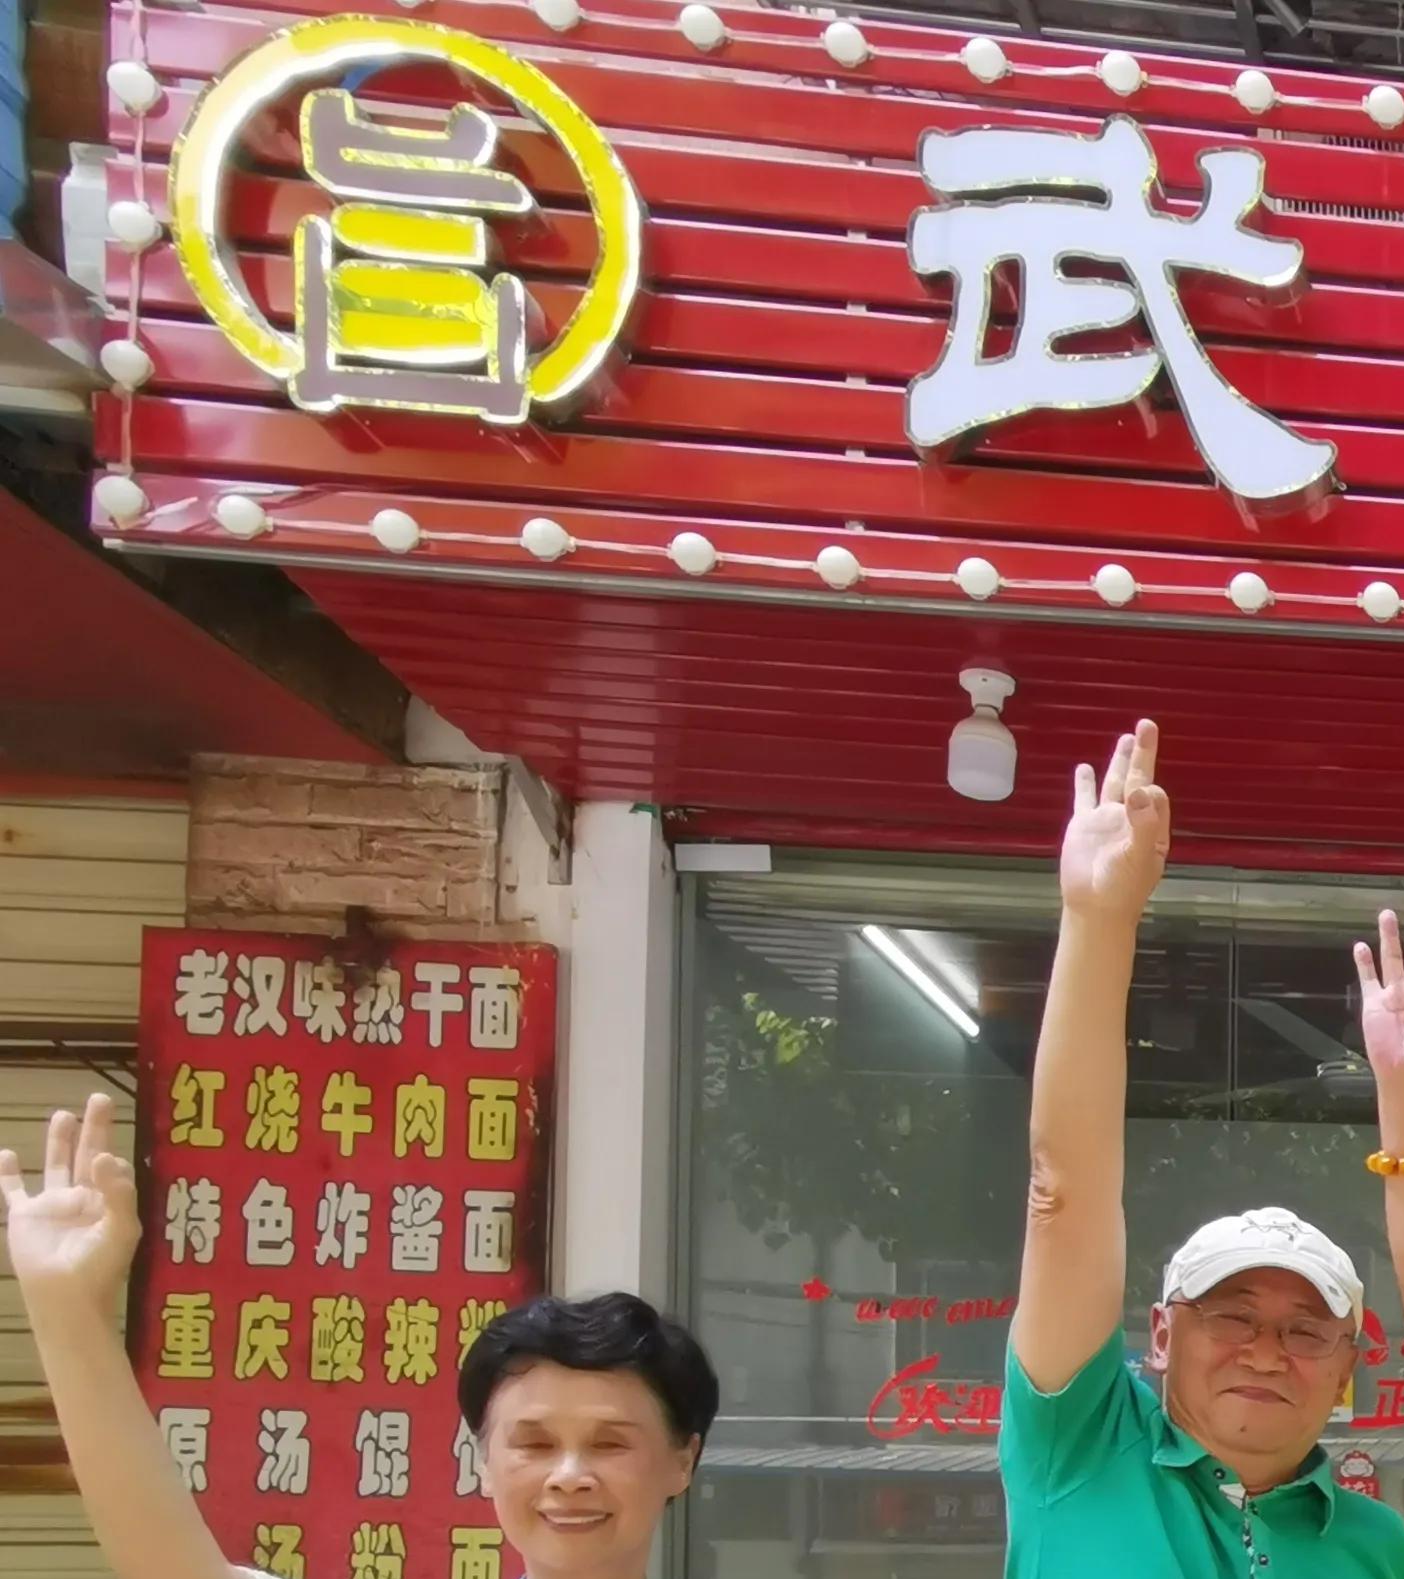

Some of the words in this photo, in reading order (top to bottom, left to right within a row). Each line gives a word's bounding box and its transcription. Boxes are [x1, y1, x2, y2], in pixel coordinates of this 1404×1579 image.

[174, 948, 521, 1049] 老汉味热干面
[170, 1064, 520, 1161] 红烧牛肉面
[164, 1177, 516, 1273] 特色炸酱面
